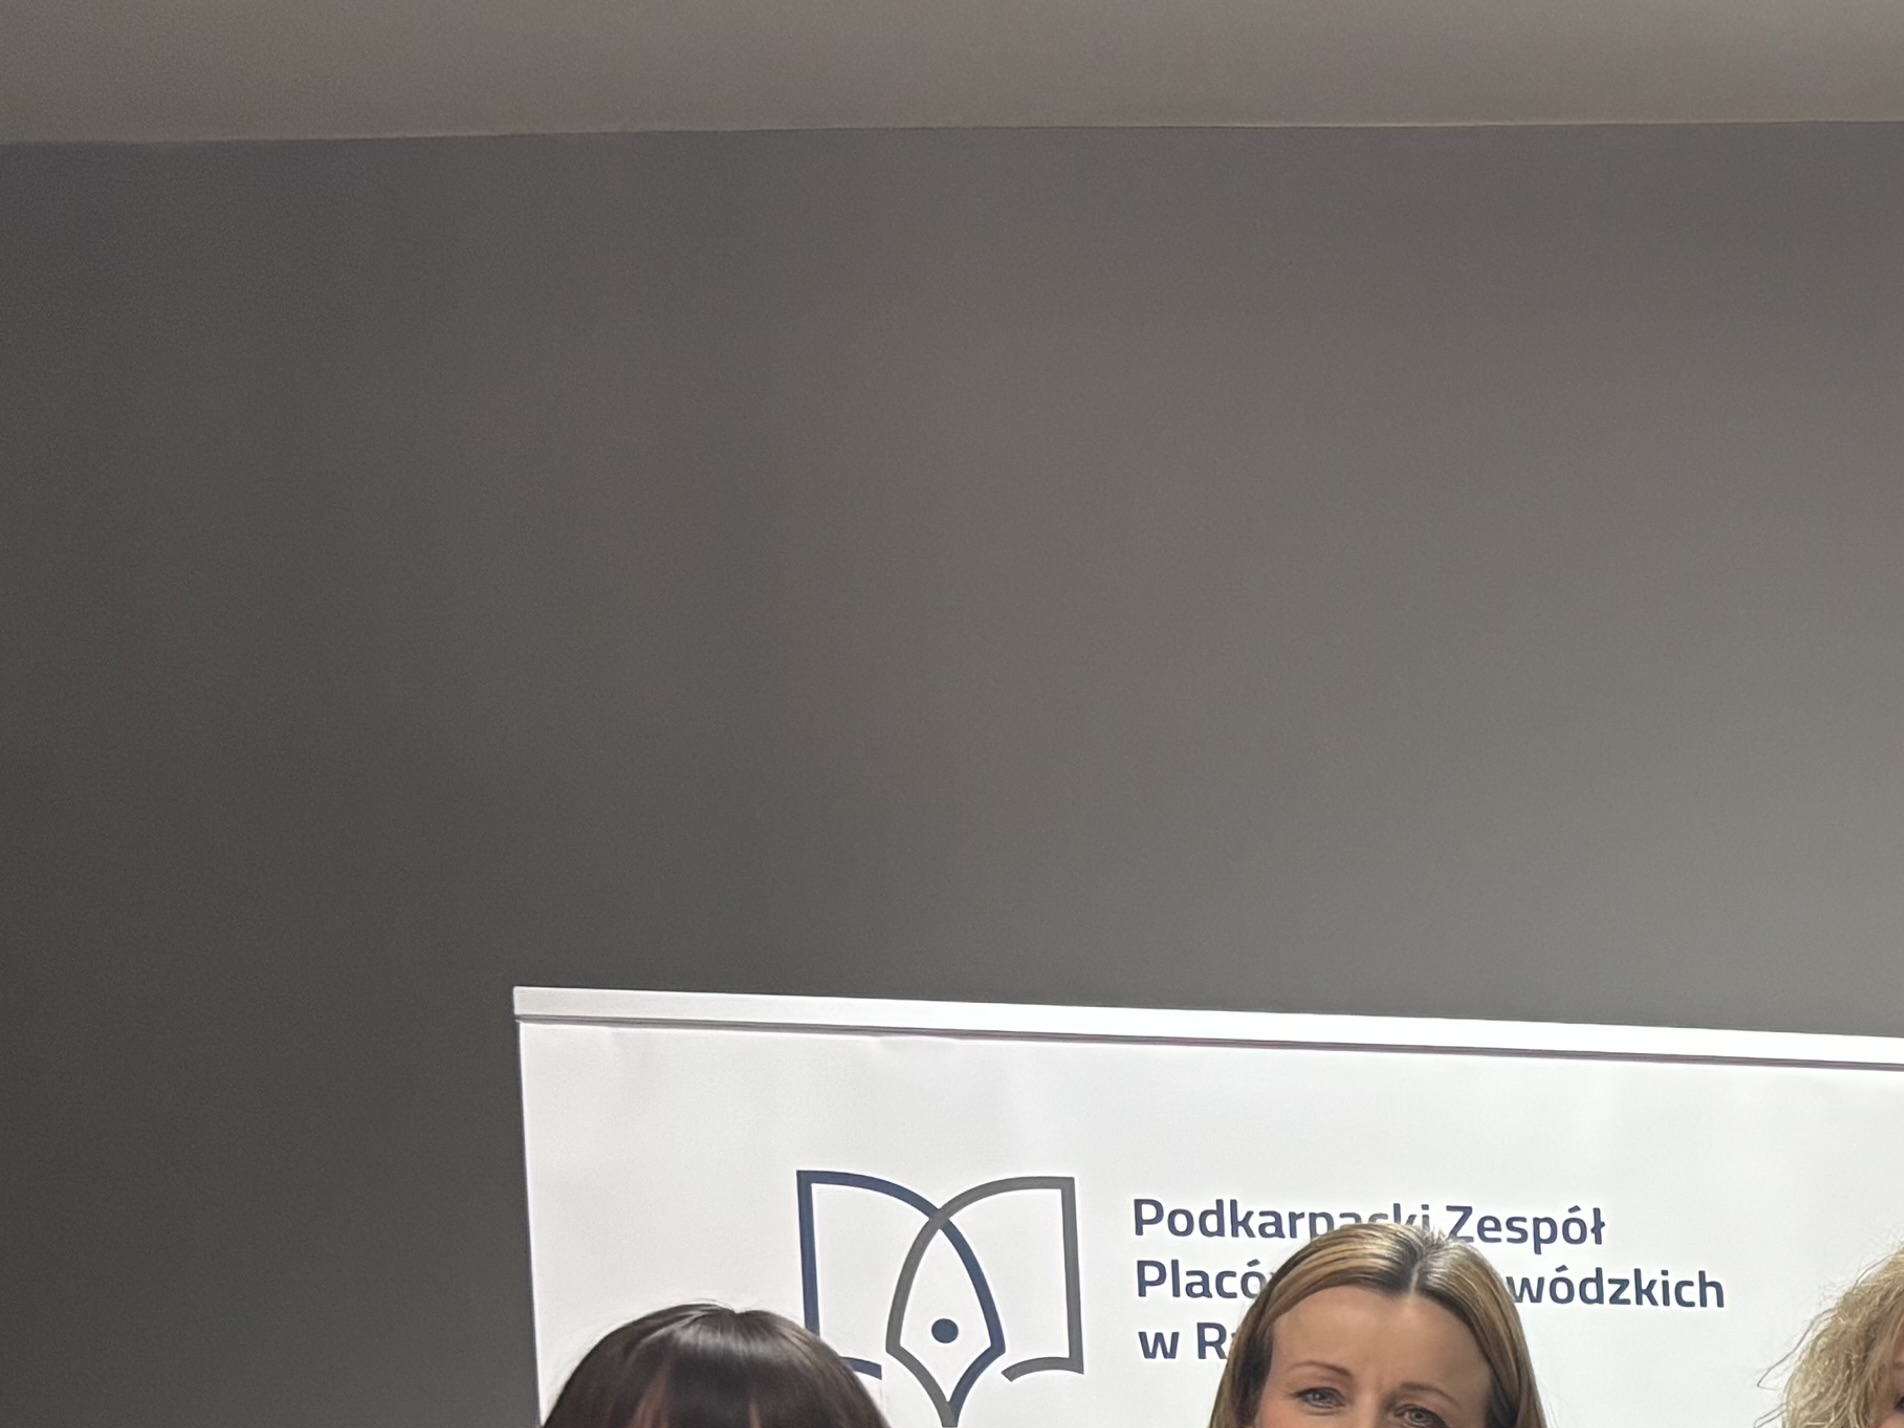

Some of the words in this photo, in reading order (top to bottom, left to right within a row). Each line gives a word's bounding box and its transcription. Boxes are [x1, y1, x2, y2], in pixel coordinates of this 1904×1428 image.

[1446, 1205, 1606, 1255] Zespół
[1136, 1258, 1264, 1300] Placó
[1139, 1329, 1180, 1359] w
